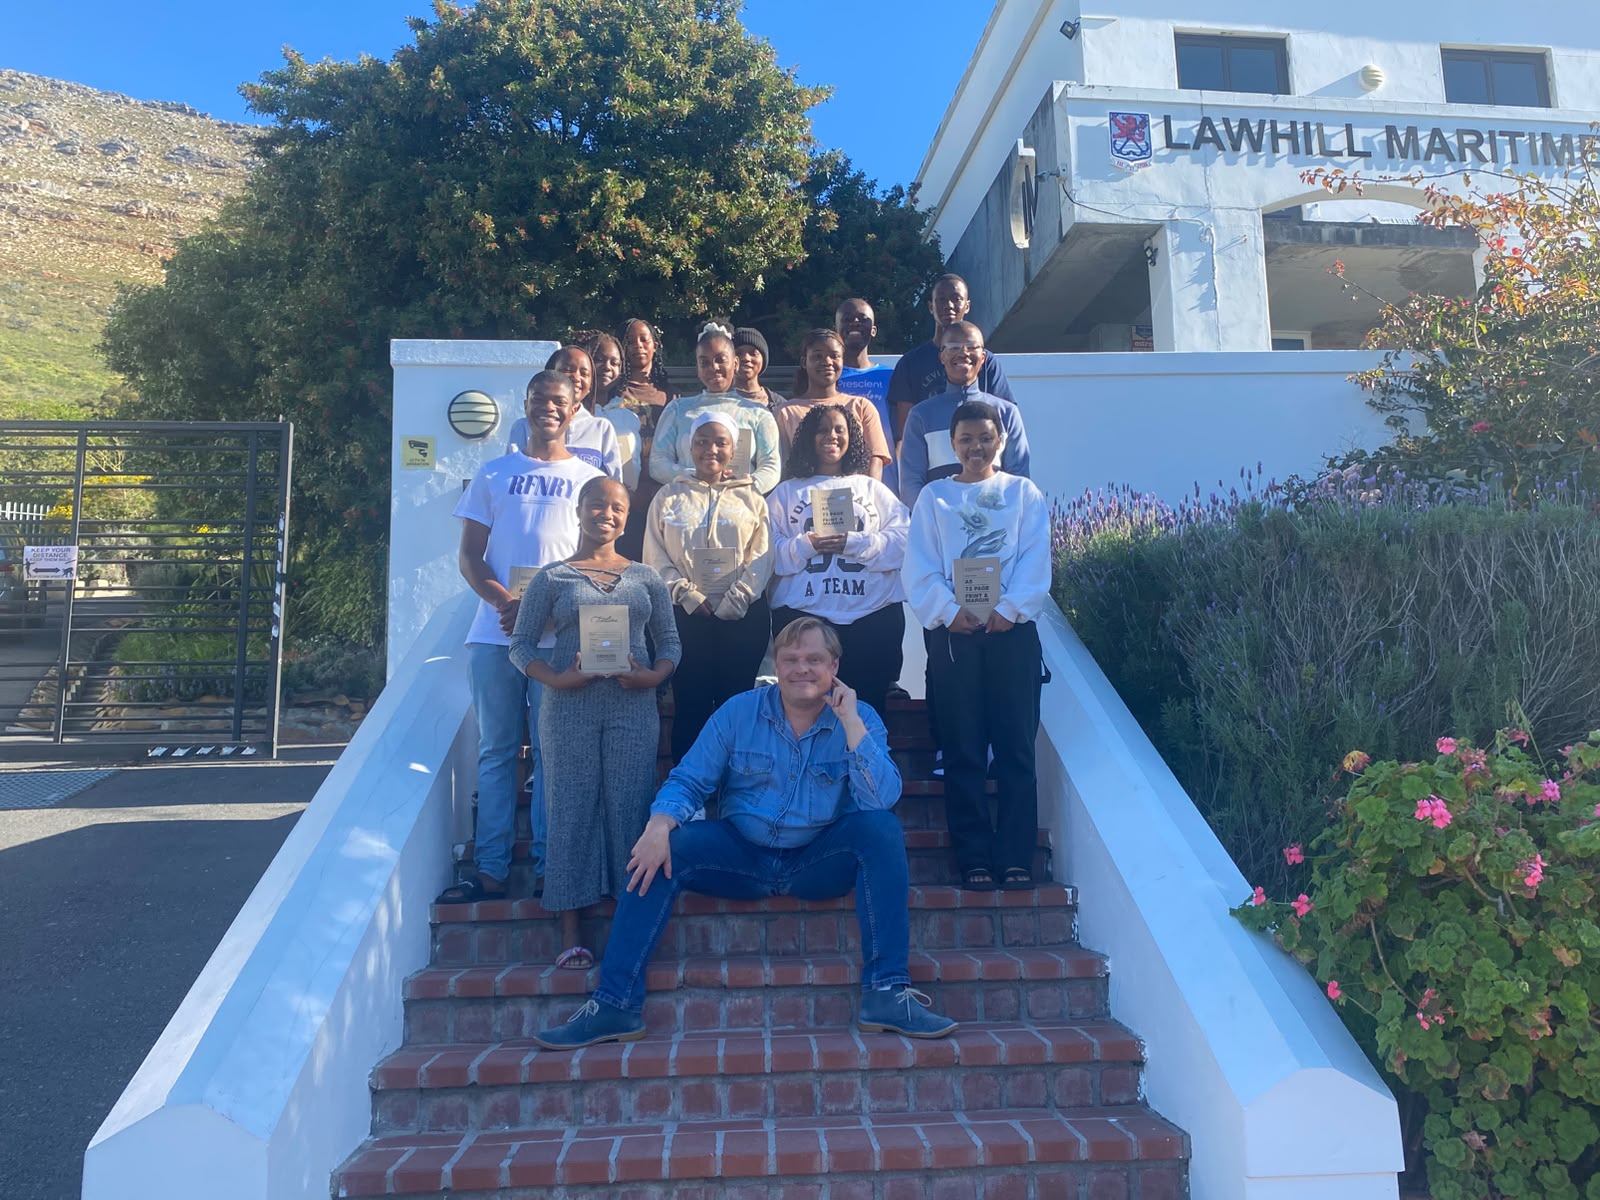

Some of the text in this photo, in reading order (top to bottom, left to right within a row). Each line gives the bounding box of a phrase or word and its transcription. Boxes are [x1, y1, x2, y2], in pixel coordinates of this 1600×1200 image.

[1163, 114, 1600, 168] LAWHILL MARITIME
[837, 379, 883, 389] Prescient
[508, 475, 579, 499] RFNRY
[805, 577, 865, 597] A TEAM
